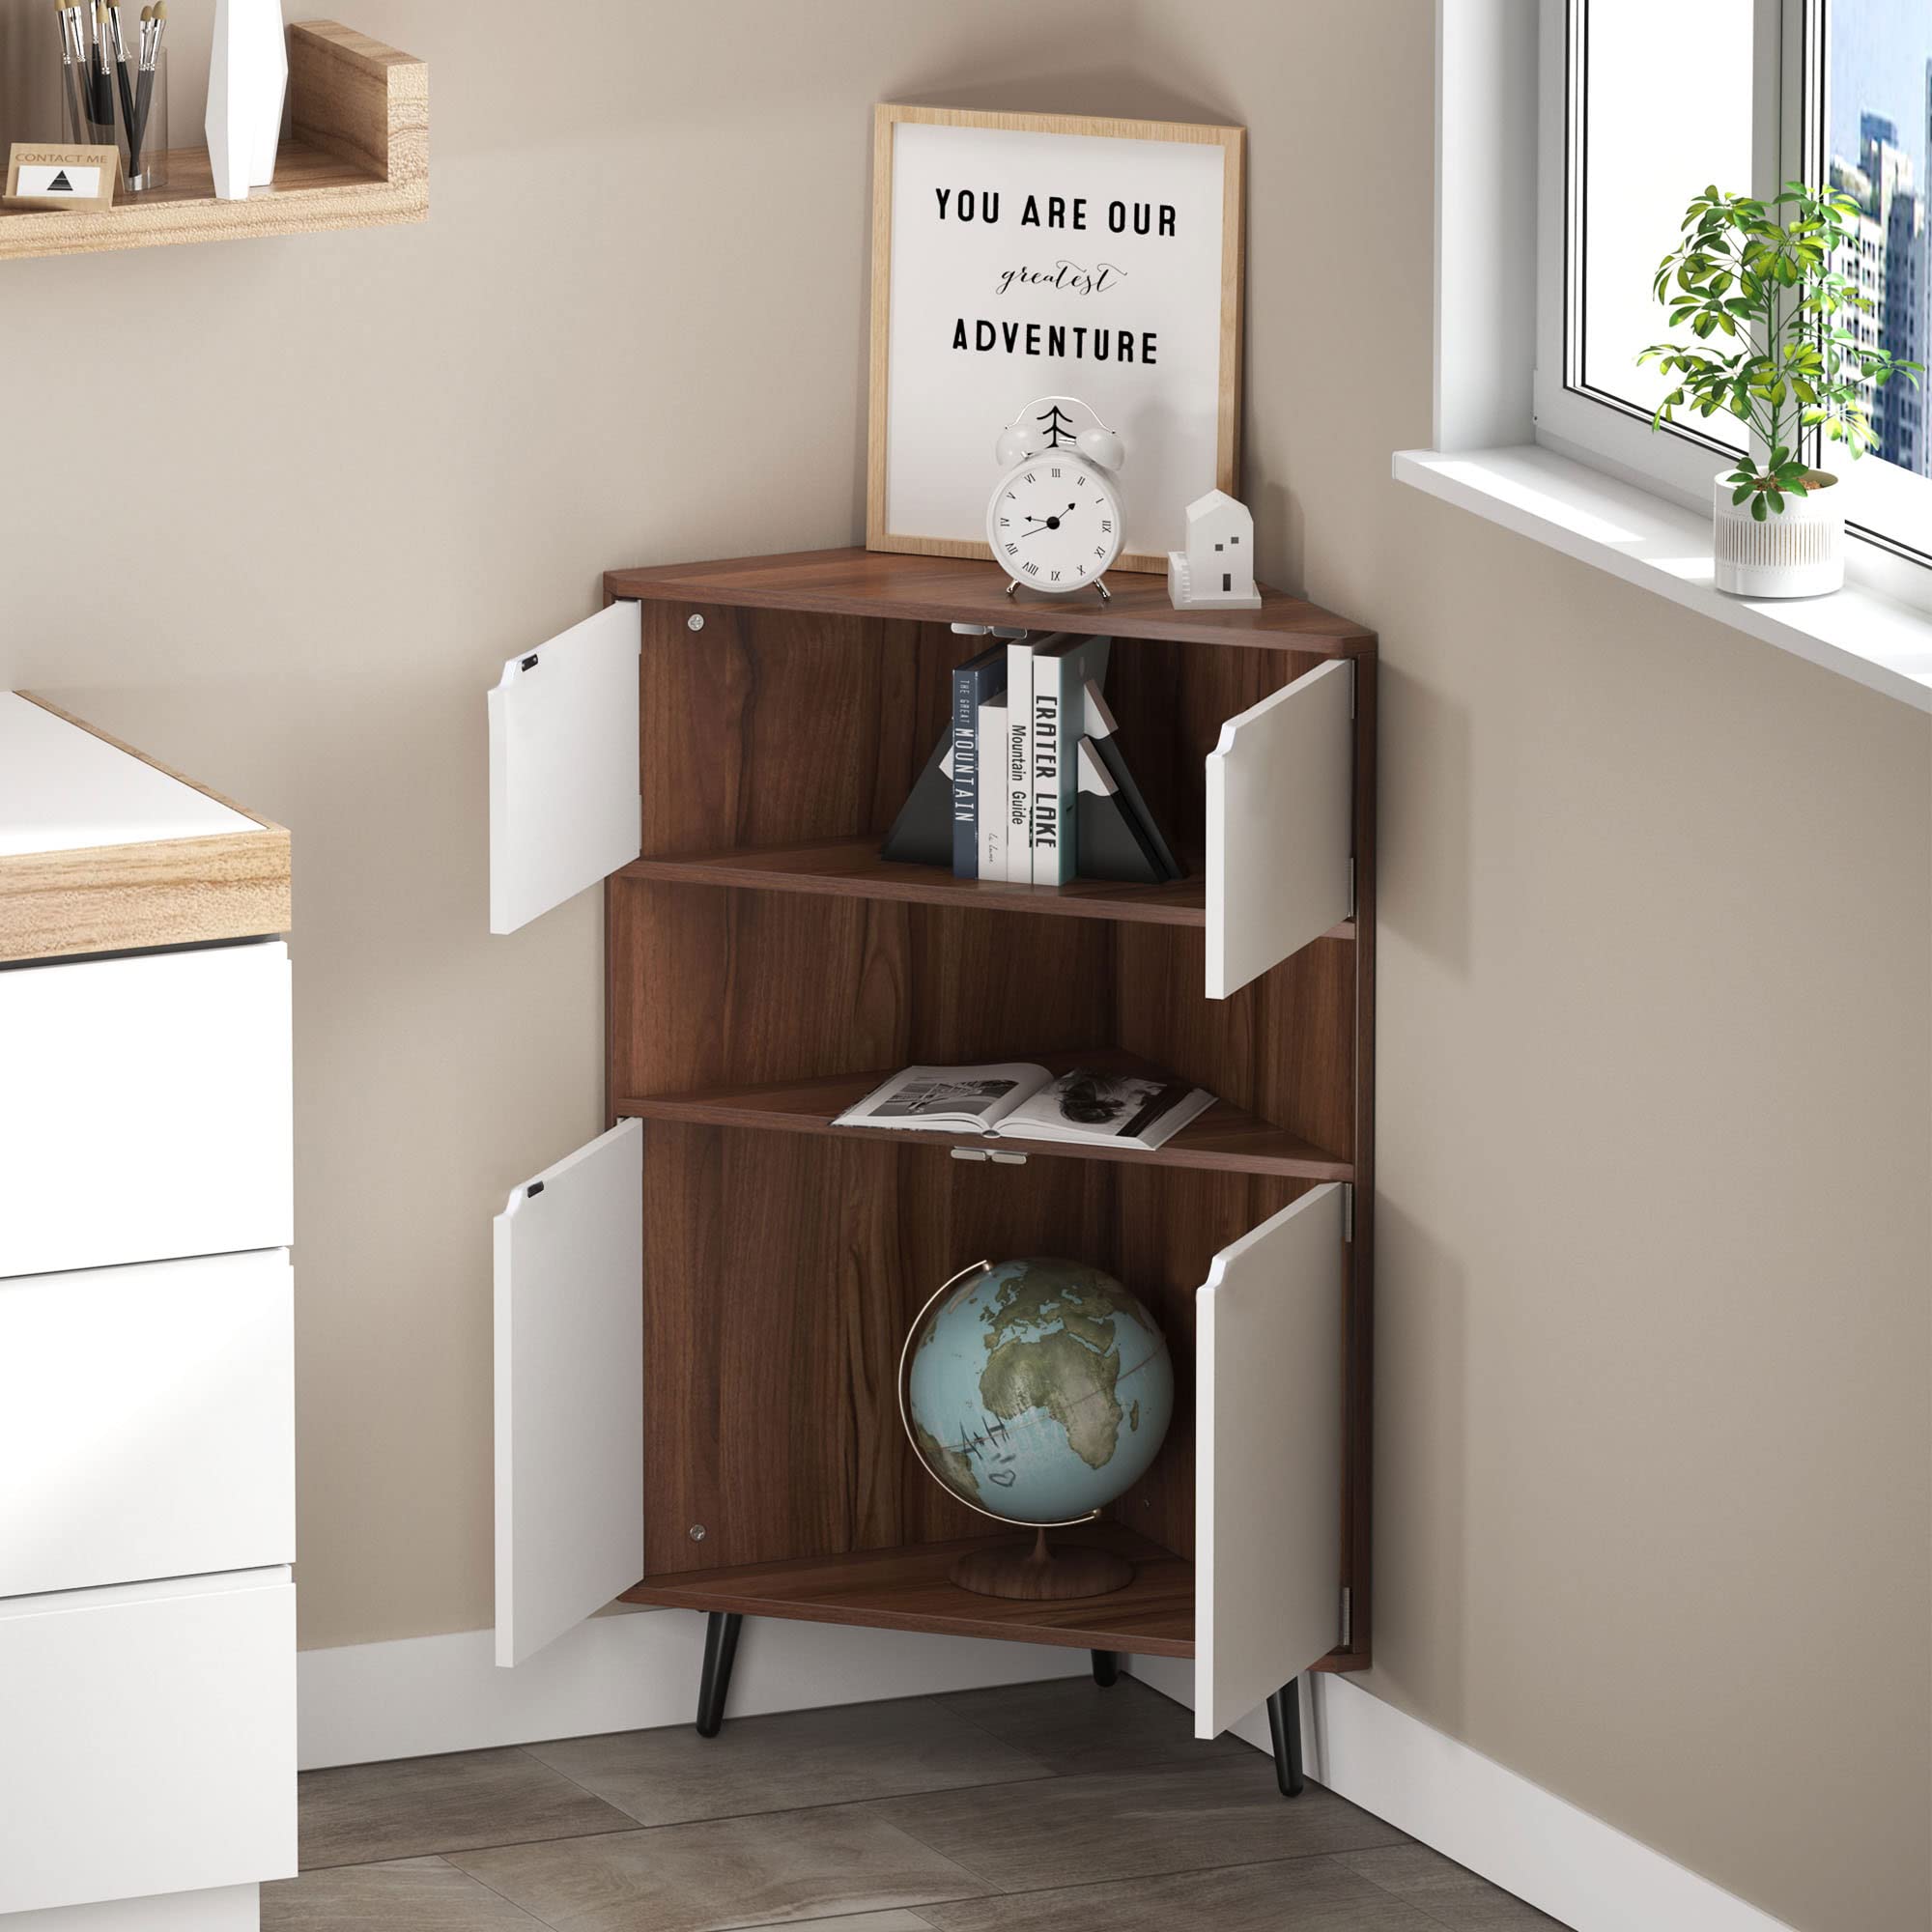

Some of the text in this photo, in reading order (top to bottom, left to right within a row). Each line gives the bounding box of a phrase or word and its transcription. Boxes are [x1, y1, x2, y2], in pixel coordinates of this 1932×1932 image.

[14, 153, 109, 164] CONTACT ME
[935, 187, 1177, 237] YOU ARE OUR
[995, 260, 1128, 296] greatest
[952, 318, 1158, 365] ADVENTURE
[959, 680, 970, 724] THE GREAT
[954, 727, 975, 822] MOUNTAIN
[1011, 724, 1027, 825] Mountain Guide
[1036, 695, 1058, 848] CRATER LAKE
